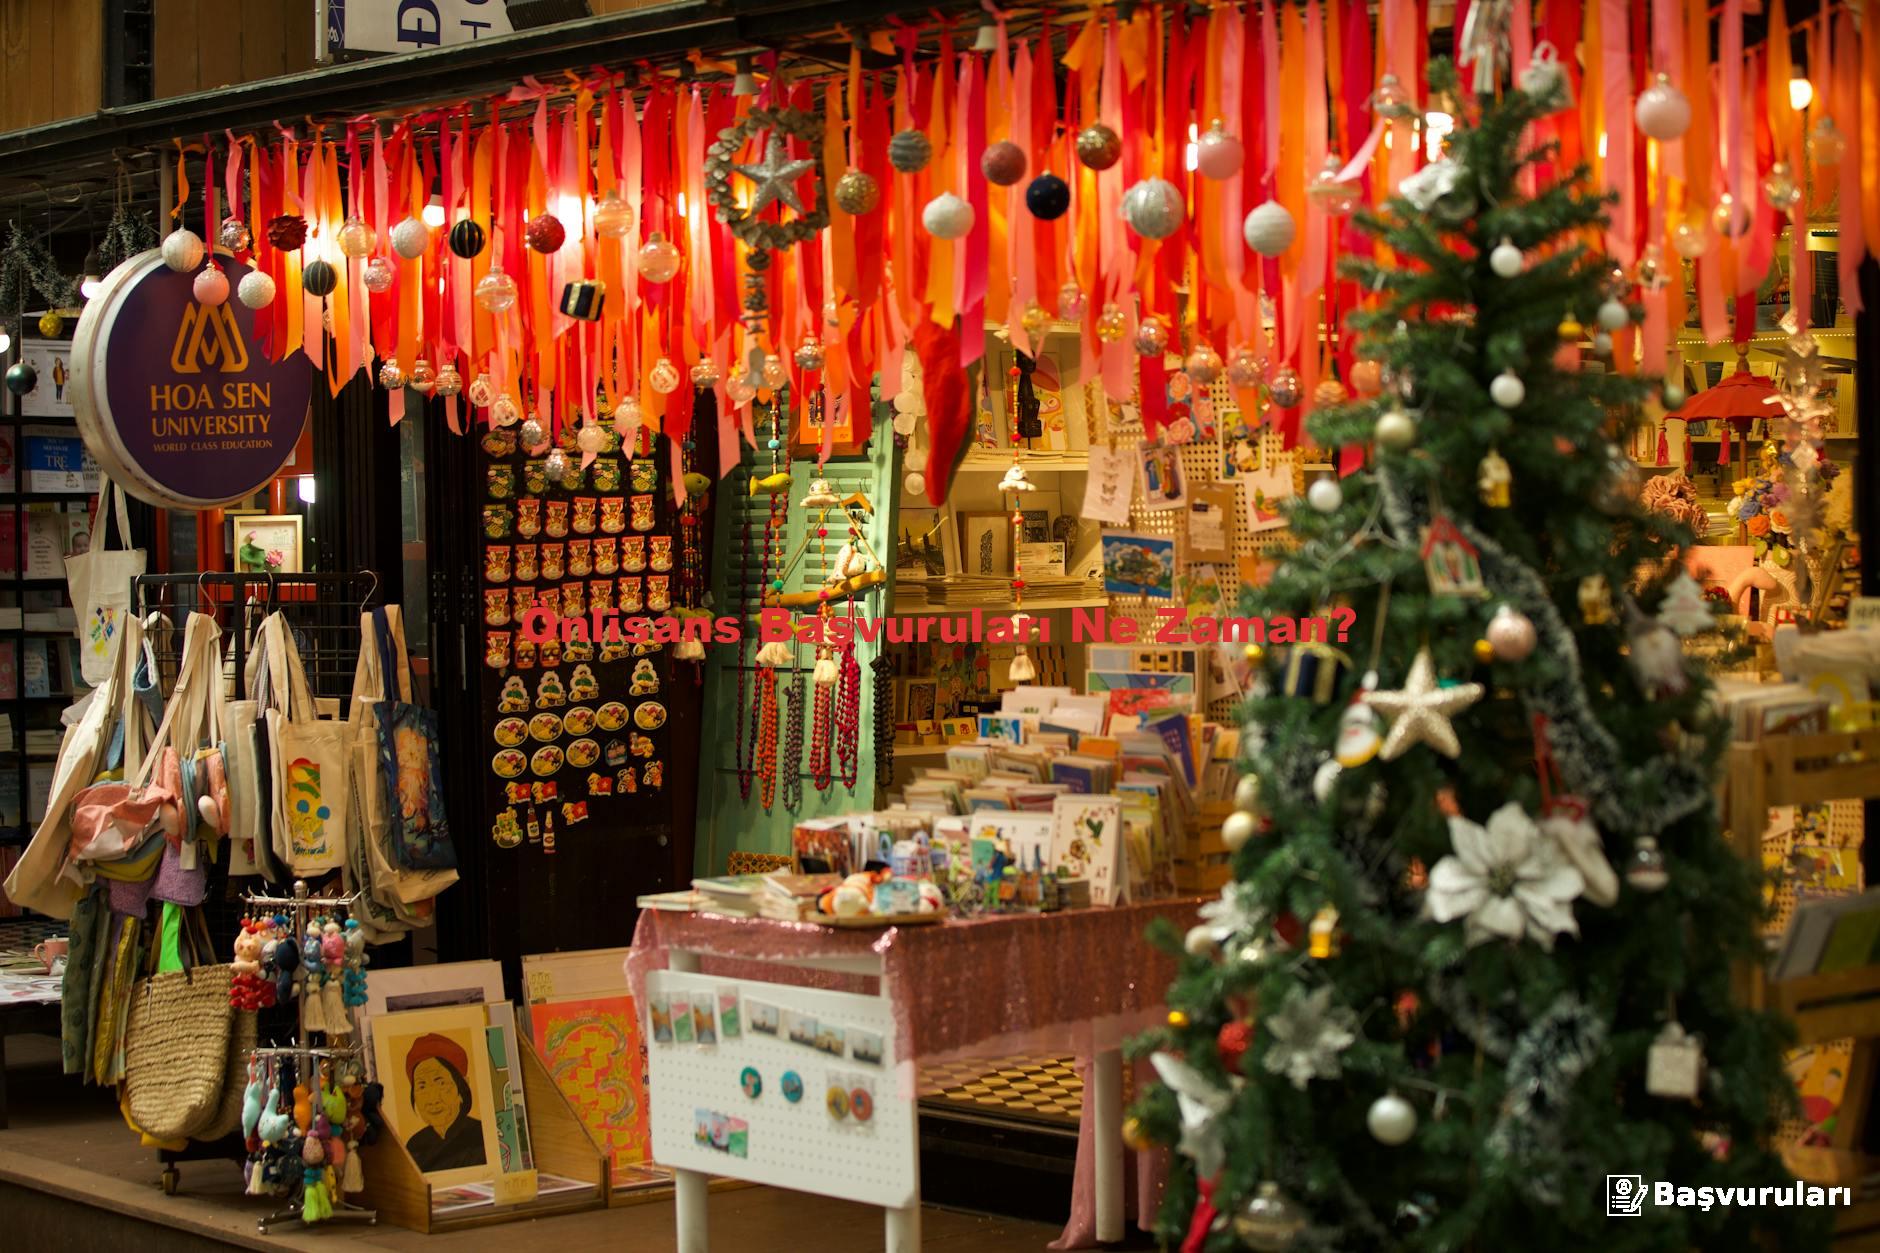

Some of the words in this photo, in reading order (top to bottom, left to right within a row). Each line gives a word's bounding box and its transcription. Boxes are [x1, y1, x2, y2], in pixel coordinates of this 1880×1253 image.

[151, 383, 215, 411] HOA
[222, 382, 271, 409] SEN
[151, 414, 271, 437] UNIVERSITY
[153, 442, 187, 452] WORLD
[191, 441, 218, 450] CLASS
[221, 439, 273, 449] EDUCATION
